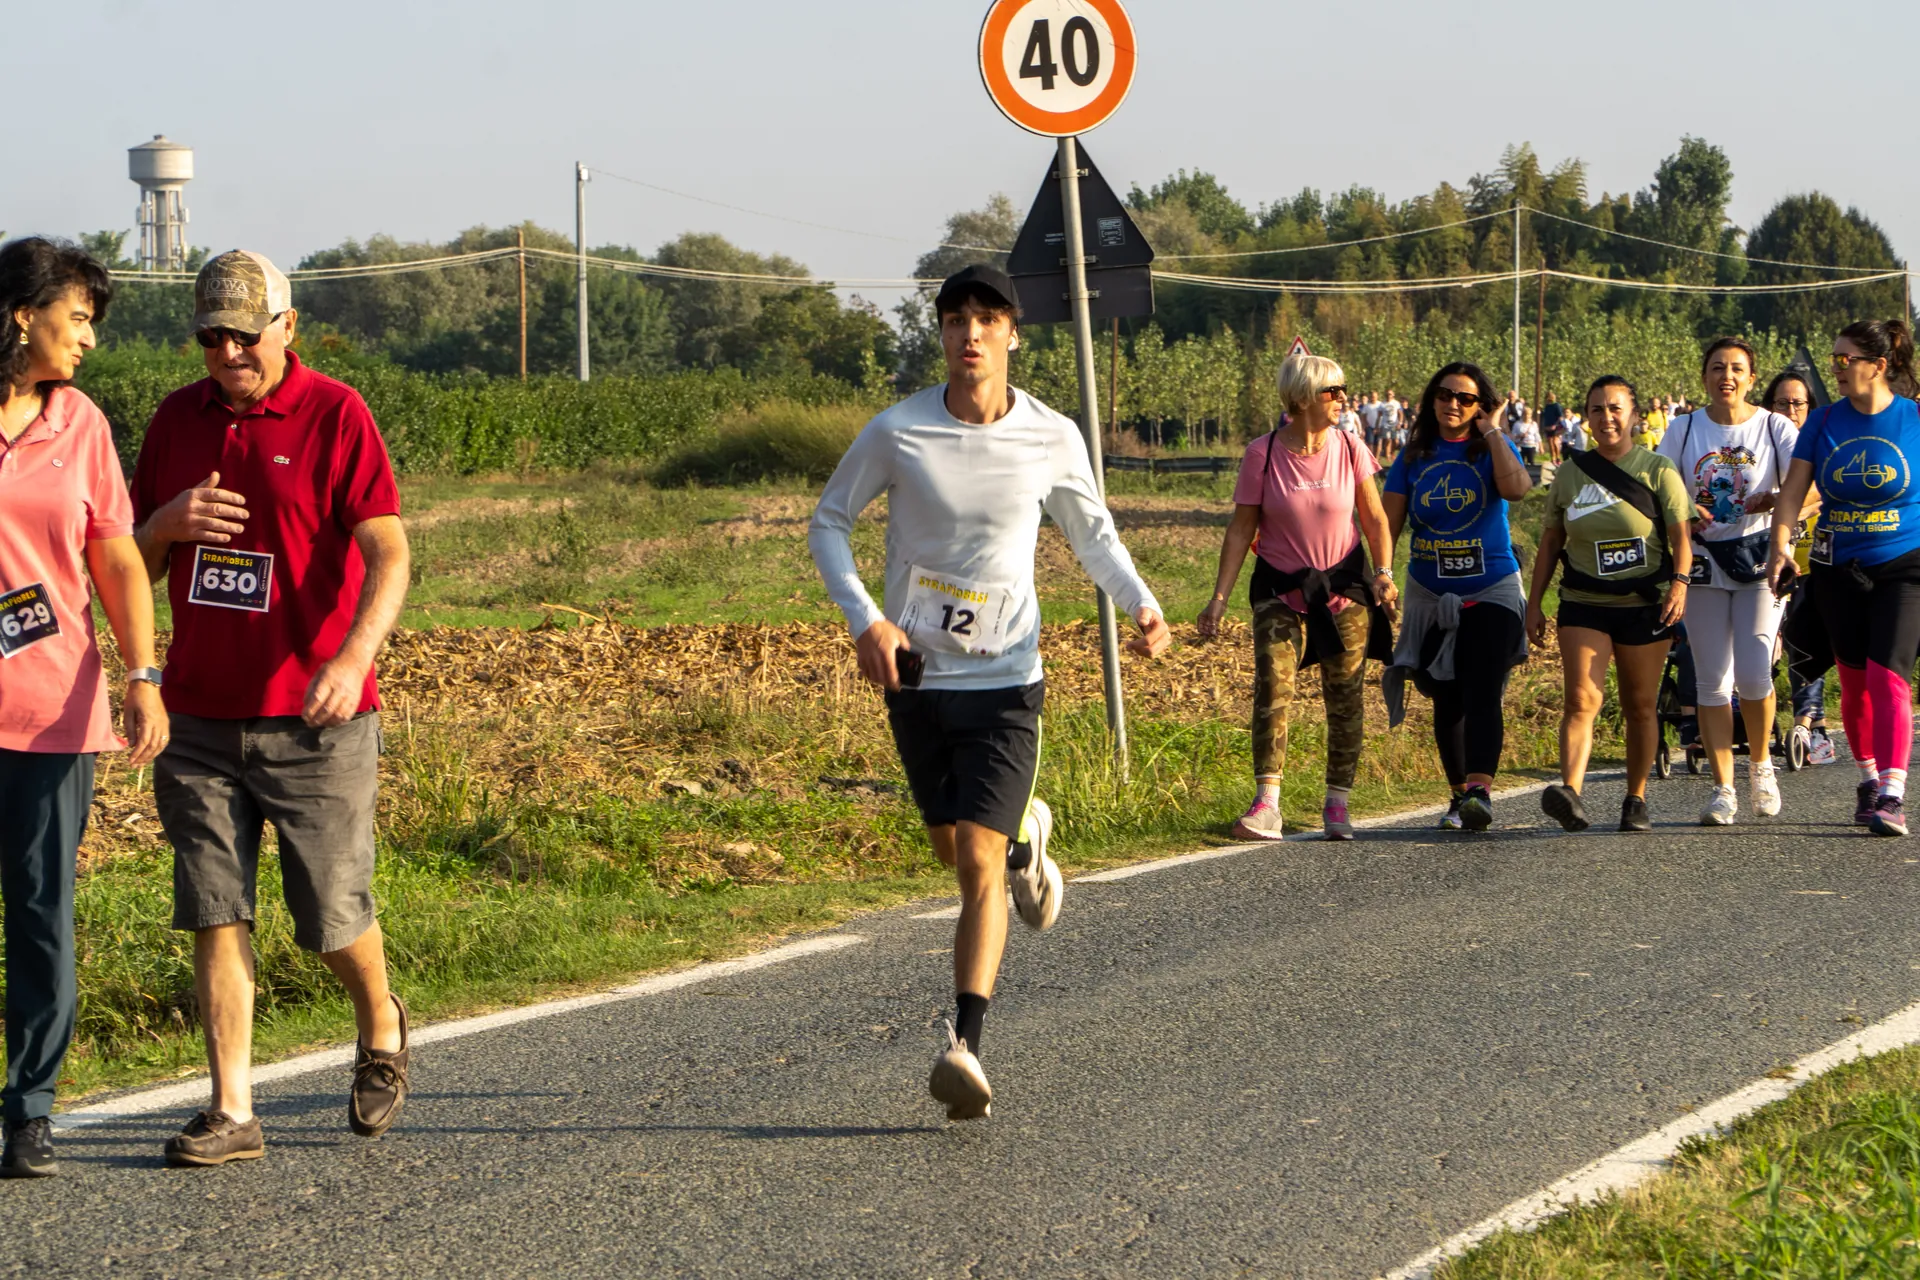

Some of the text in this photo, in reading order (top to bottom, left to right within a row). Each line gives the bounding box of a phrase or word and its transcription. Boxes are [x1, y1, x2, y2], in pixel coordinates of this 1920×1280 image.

[1019, 16, 1100, 90] 40
[205, 279, 249, 292] IOWA
[1444, 557, 1474, 570] 539
[1603, 549, 1637, 566] 506
[203, 568, 257, 594] 630
[2, 602, 51, 637] 629
[941, 604, 975, 636] 12
